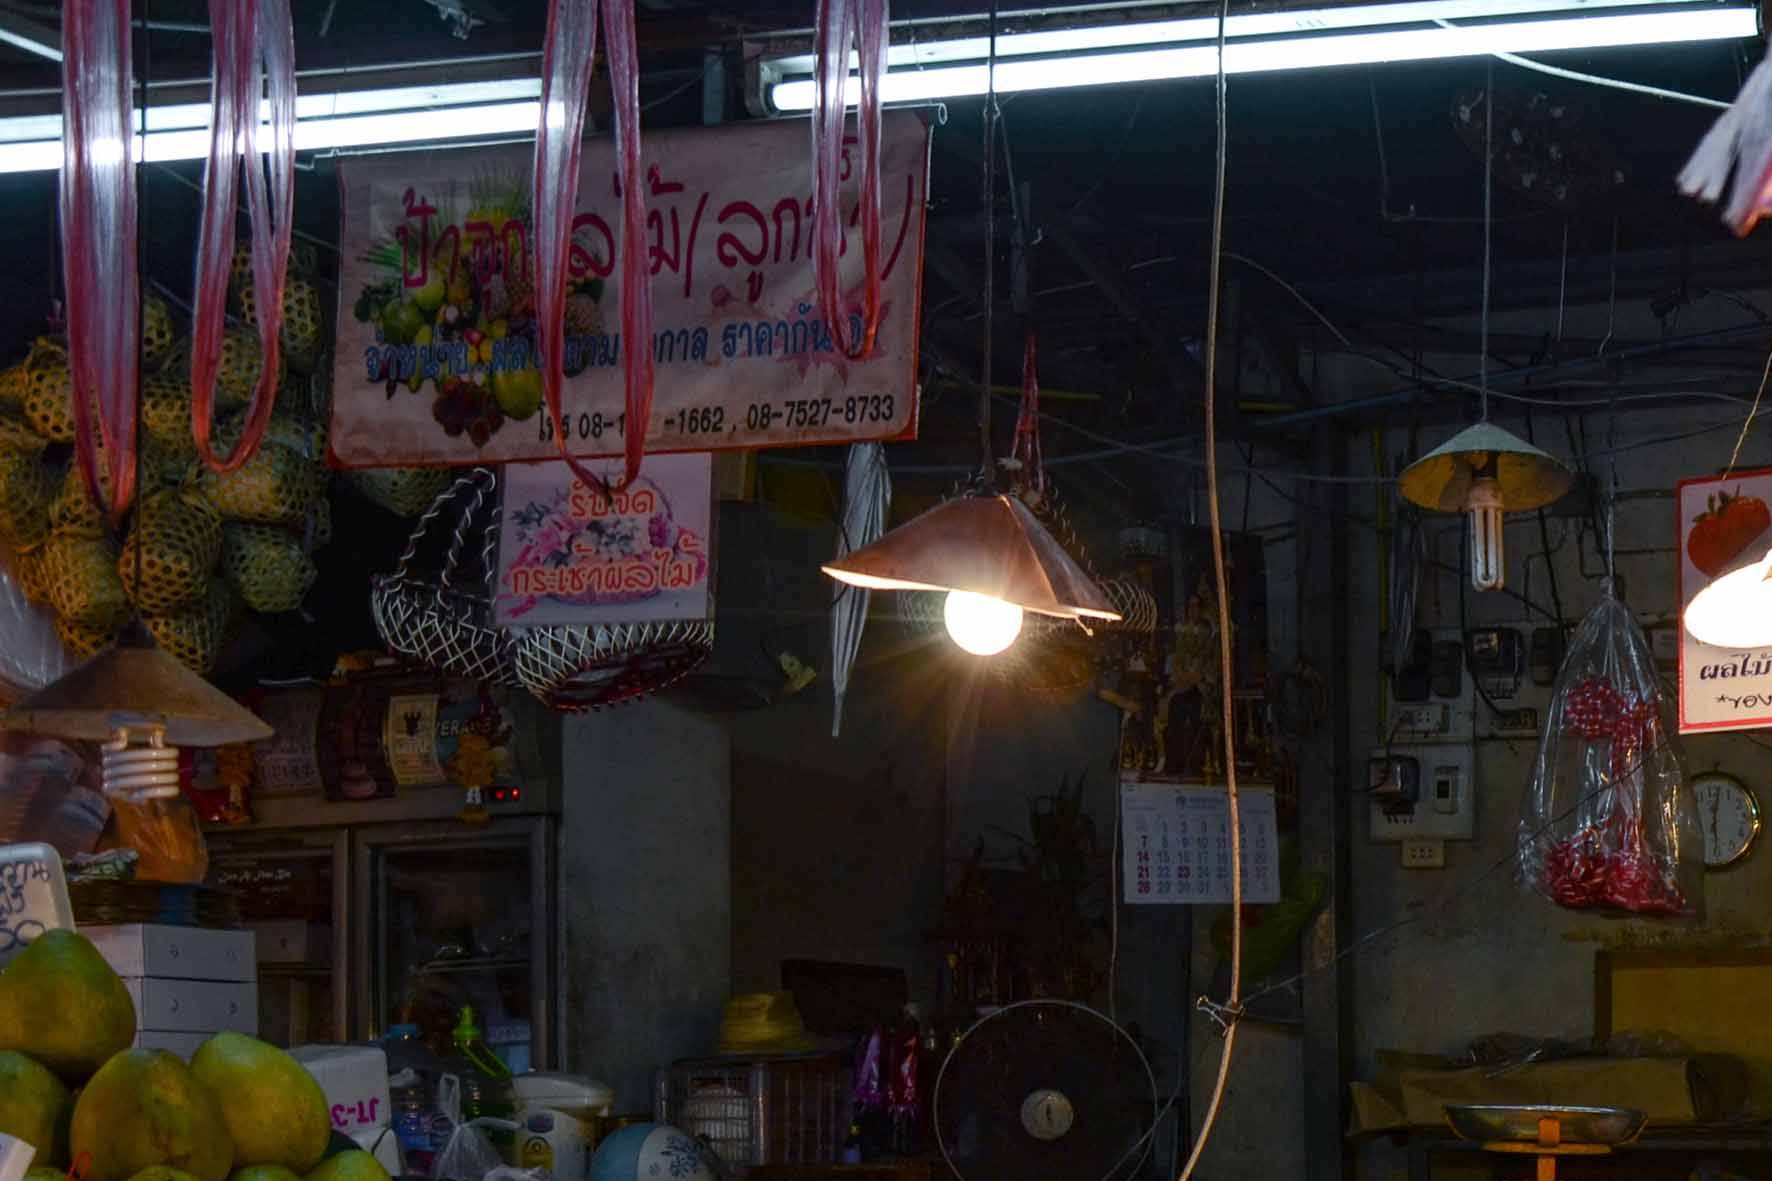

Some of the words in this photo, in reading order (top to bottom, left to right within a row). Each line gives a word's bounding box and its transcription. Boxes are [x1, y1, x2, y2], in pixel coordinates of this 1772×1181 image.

[746, 394, 895, 431] 08-7527-8733
[513, 536, 698, 594] กระเช้าผลไม้
